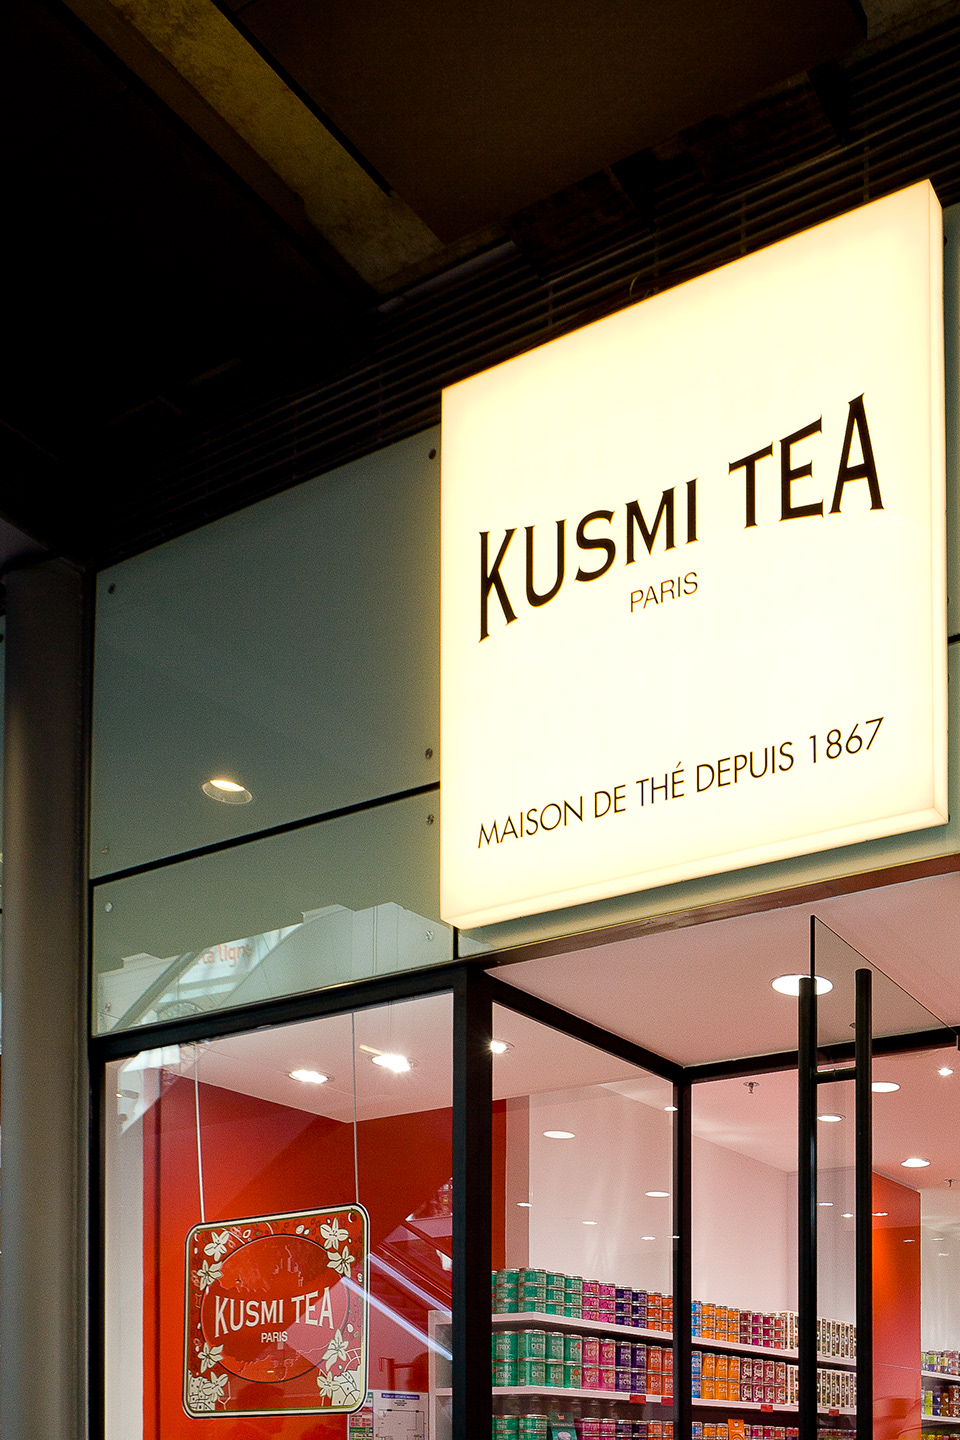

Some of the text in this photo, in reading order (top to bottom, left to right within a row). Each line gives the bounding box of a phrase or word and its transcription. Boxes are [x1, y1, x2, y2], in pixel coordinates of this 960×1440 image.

[478, 392, 885, 643] KUSMI TEA
[630, 571, 699, 613] PARIS
[478, 716, 885, 849] MAISON DE THÉ DEPUIS 1867
[215, 1286, 334, 1339] KUSMI TEA
[261, 1331, 288, 1343] PARIS
